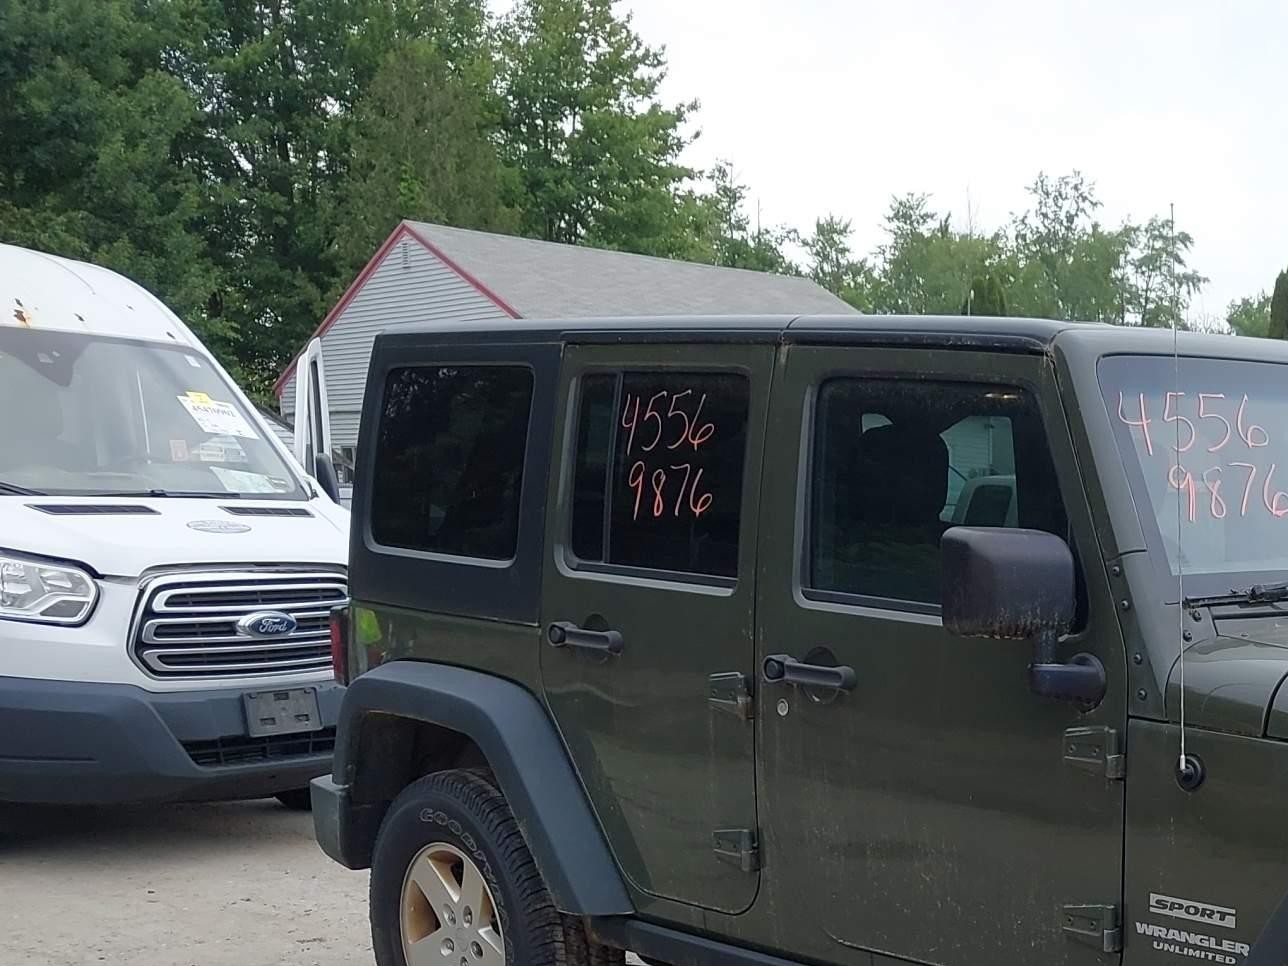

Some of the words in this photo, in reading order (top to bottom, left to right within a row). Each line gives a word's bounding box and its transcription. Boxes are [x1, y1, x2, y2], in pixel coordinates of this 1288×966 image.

[622, 388, 715, 457] 4556
[1117, 391, 1270, 456] 4556
[628, 460, 713, 521] 9876
[258, 618, 288, 633] Ford
[1152, 897, 1236, 924] SPORT
[1135, 921, 1250, 957] WRANGLER
[1152, 940, 1237, 965] UNLIMITED
